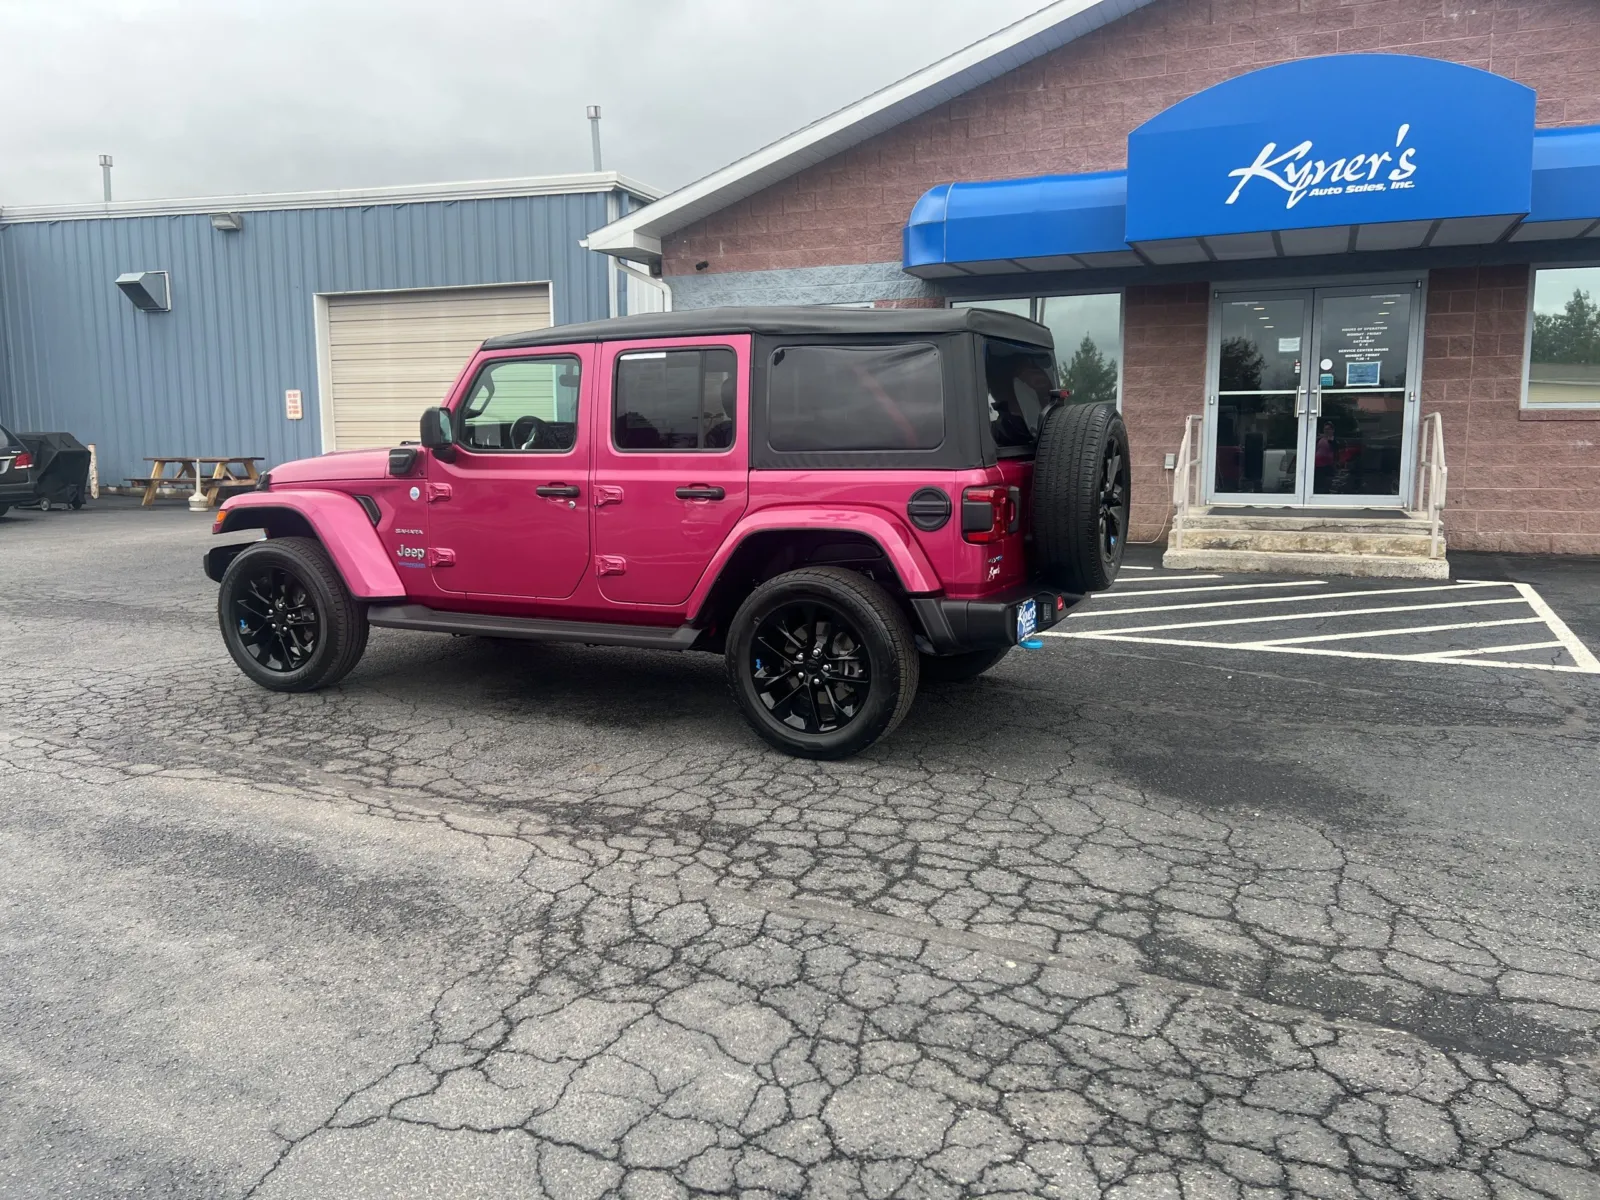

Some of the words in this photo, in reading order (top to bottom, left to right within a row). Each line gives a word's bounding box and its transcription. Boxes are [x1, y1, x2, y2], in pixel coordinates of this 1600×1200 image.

[1225, 123, 1417, 209] Kyner's
[1309, 187, 1342, 196] Auto
[1345, 183, 1386, 195] Sales,
[1390, 180, 1415, 190] Inc.
[397, 544, 425, 560] Jeep
